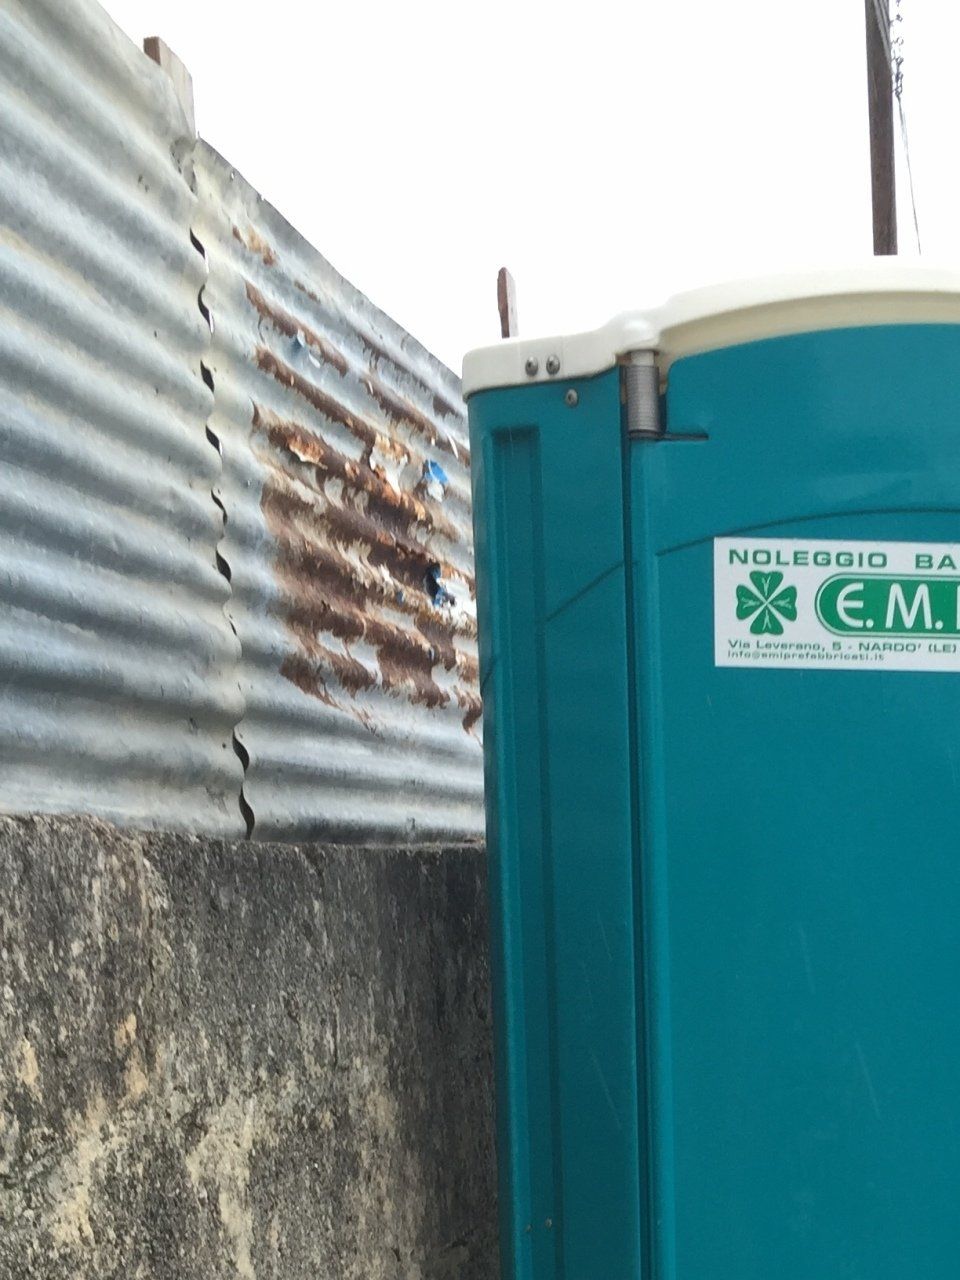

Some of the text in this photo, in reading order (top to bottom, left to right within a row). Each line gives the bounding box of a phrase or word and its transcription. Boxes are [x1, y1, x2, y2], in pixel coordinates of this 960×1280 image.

[729, 549, 887, 568] NOLEGGIO
[728, 640, 751, 650] Via
[756, 641, 826, 652] Leverano,
[928, 643, 957, 654] (LE)
